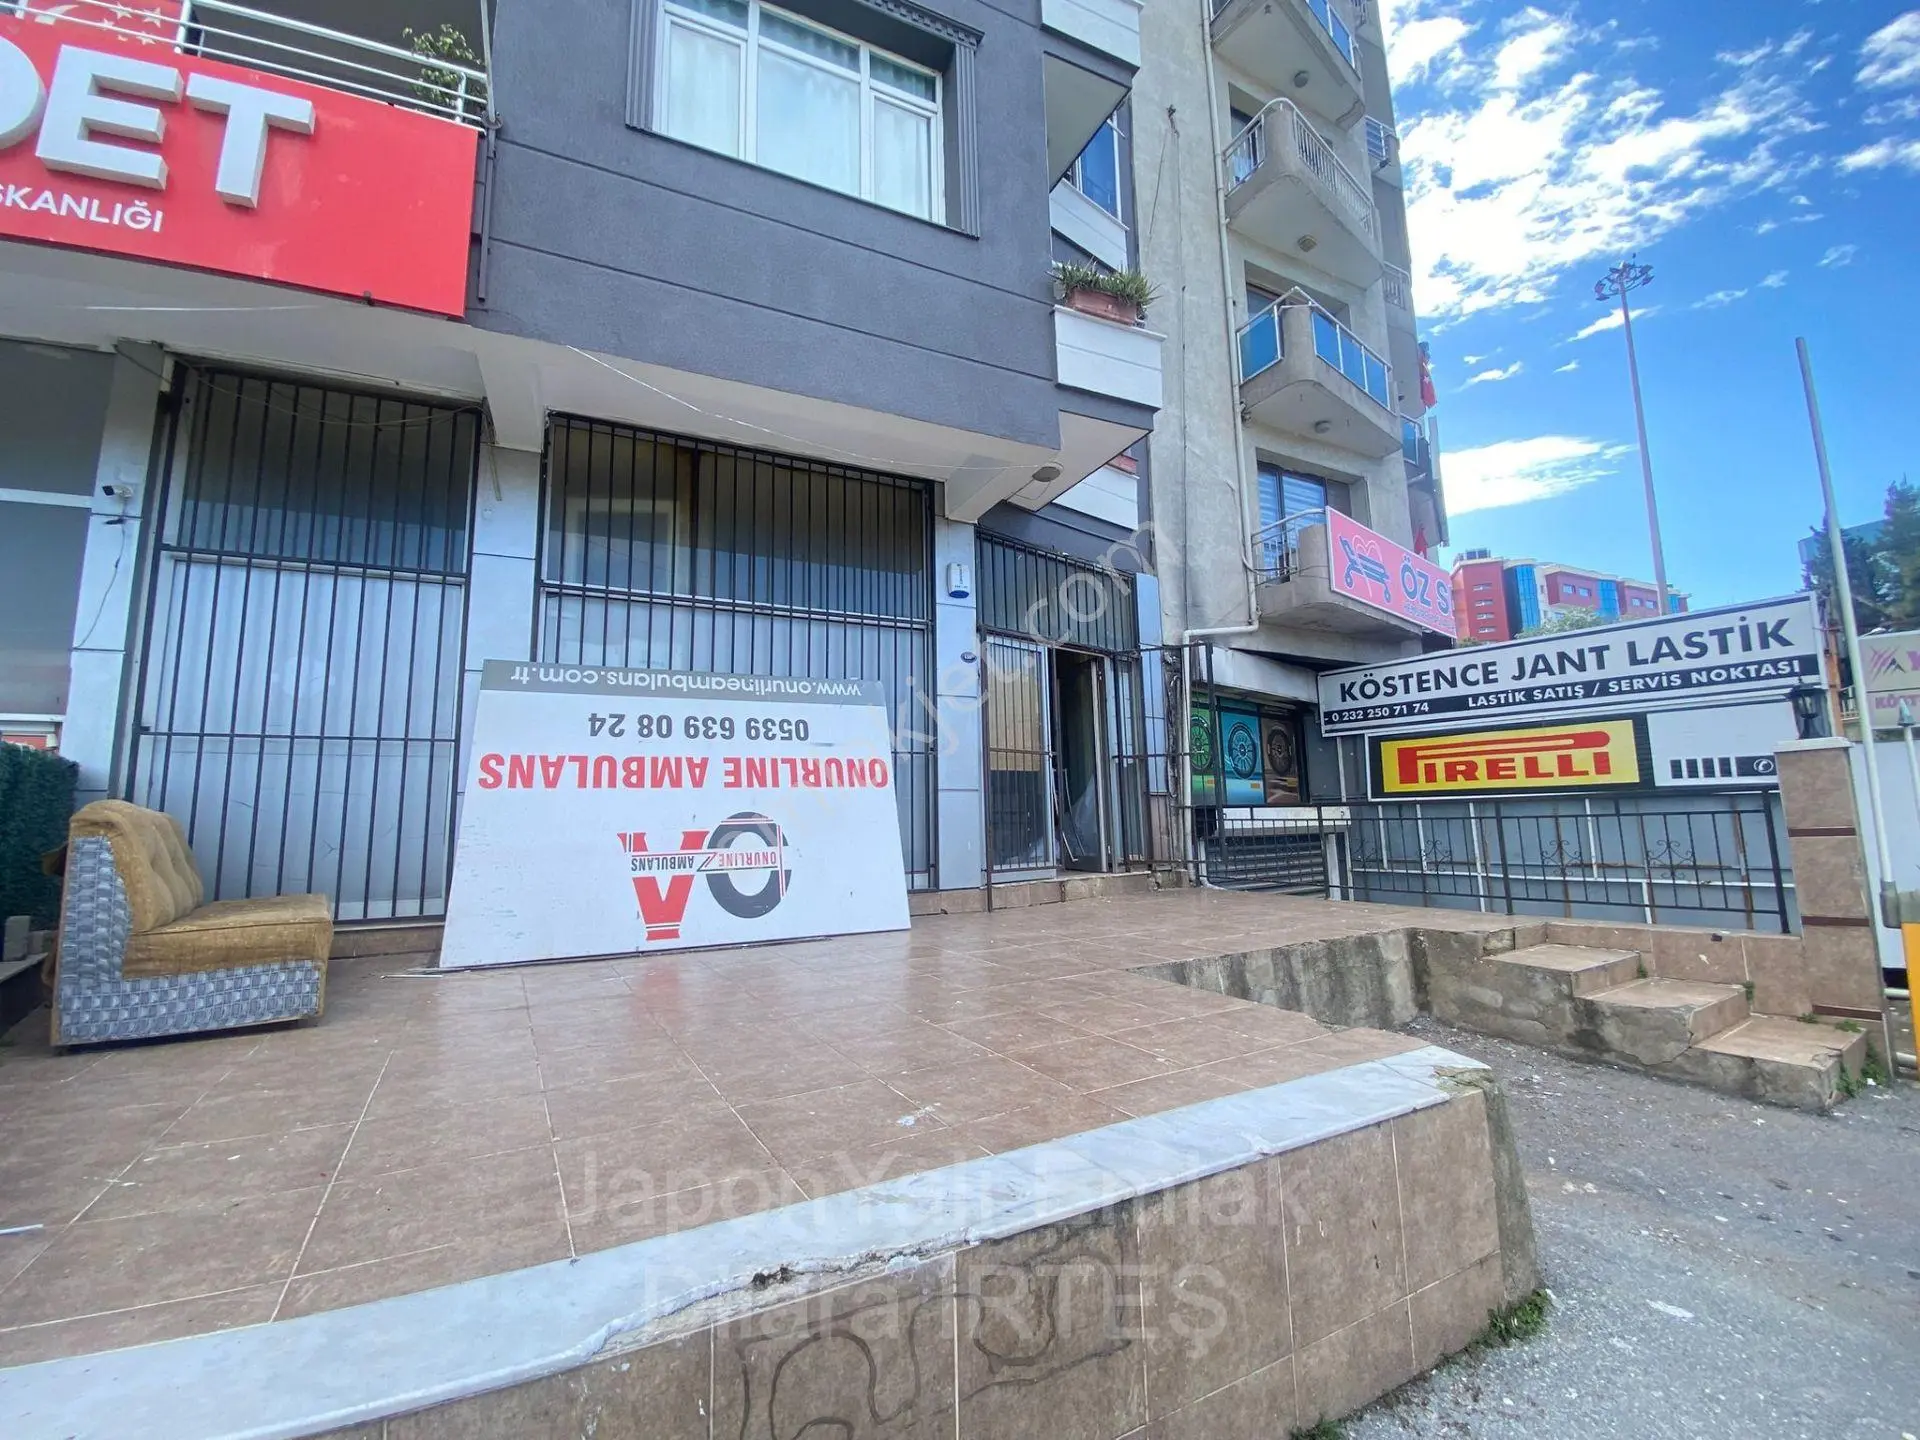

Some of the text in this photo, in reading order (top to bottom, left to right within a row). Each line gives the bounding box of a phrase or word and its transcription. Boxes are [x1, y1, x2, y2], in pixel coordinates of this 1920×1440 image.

[0, 183, 163, 232] KANLIĞI
[1339, 616, 1795, 702] KÖSTENCE JANT LASTİK
[511, 666, 862, 697] www.onurlineambulans.com.tr
[1468, 690, 1527, 708] LASTİK
[1533, 684, 1585, 699] SATIŞ
[1608, 672, 1682, 693] SERVİS
[1691, 659, 1801, 685] NOKTASI
[588, 712, 810, 741] 0539 639 08 24
[1342, 710, 1364, 721] 232
[1367, 707, 1390, 718] 250
[1393, 704, 1407, 716] 71
[1413, 702, 1430, 713] 74
[478, 753, 889, 790] ONURLINE AMBULANS
[1397, 731, 1610, 785] PIRELLI
[631, 851, 778, 872] ONURLINE AMBULANS
